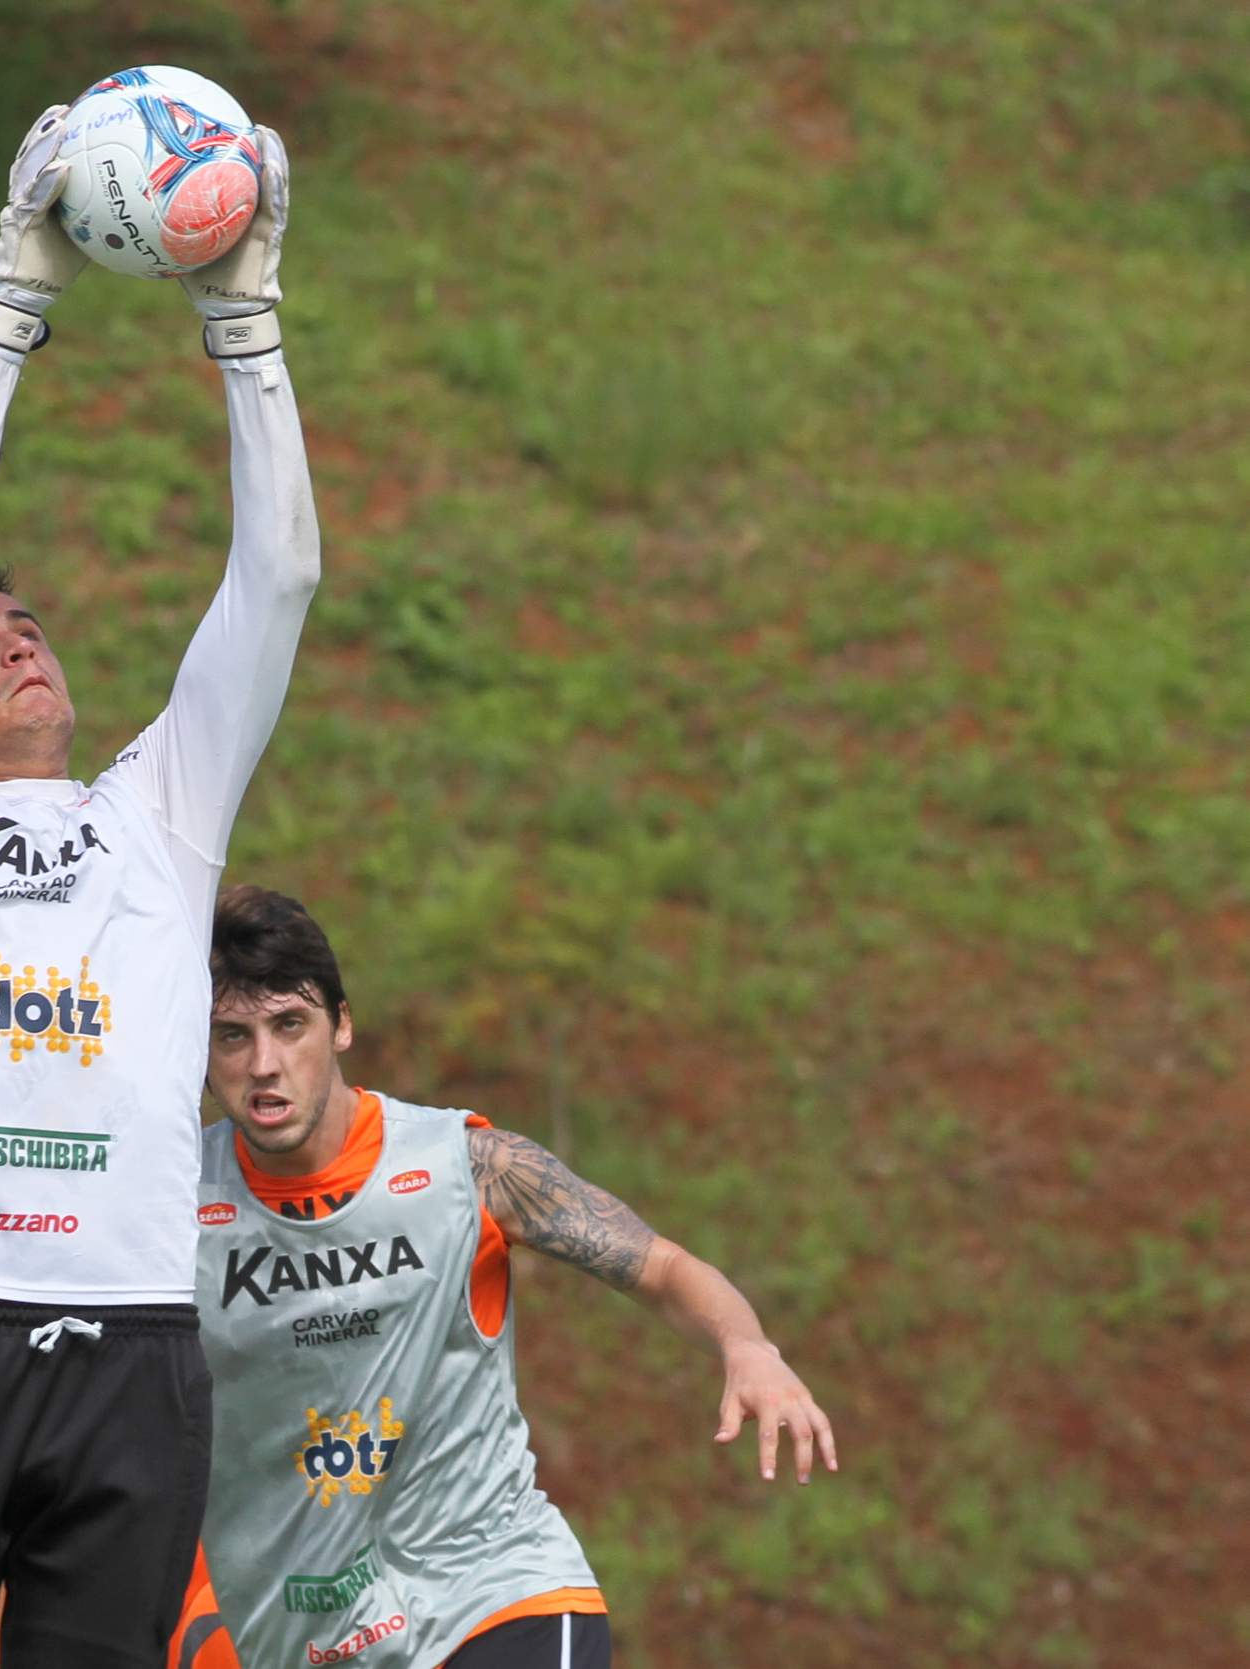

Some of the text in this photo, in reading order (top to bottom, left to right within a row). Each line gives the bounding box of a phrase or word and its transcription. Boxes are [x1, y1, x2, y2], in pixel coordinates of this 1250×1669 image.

[102, 160, 168, 266] PENALTY
[390, 1176, 429, 1193] SEARA
[222, 1235, 425, 1310] KANXA
[292, 1308, 380, 1333] CARVÃO
[294, 1326, 380, 1348] MINERAL
[307, 1613, 406, 1666] bozzano
